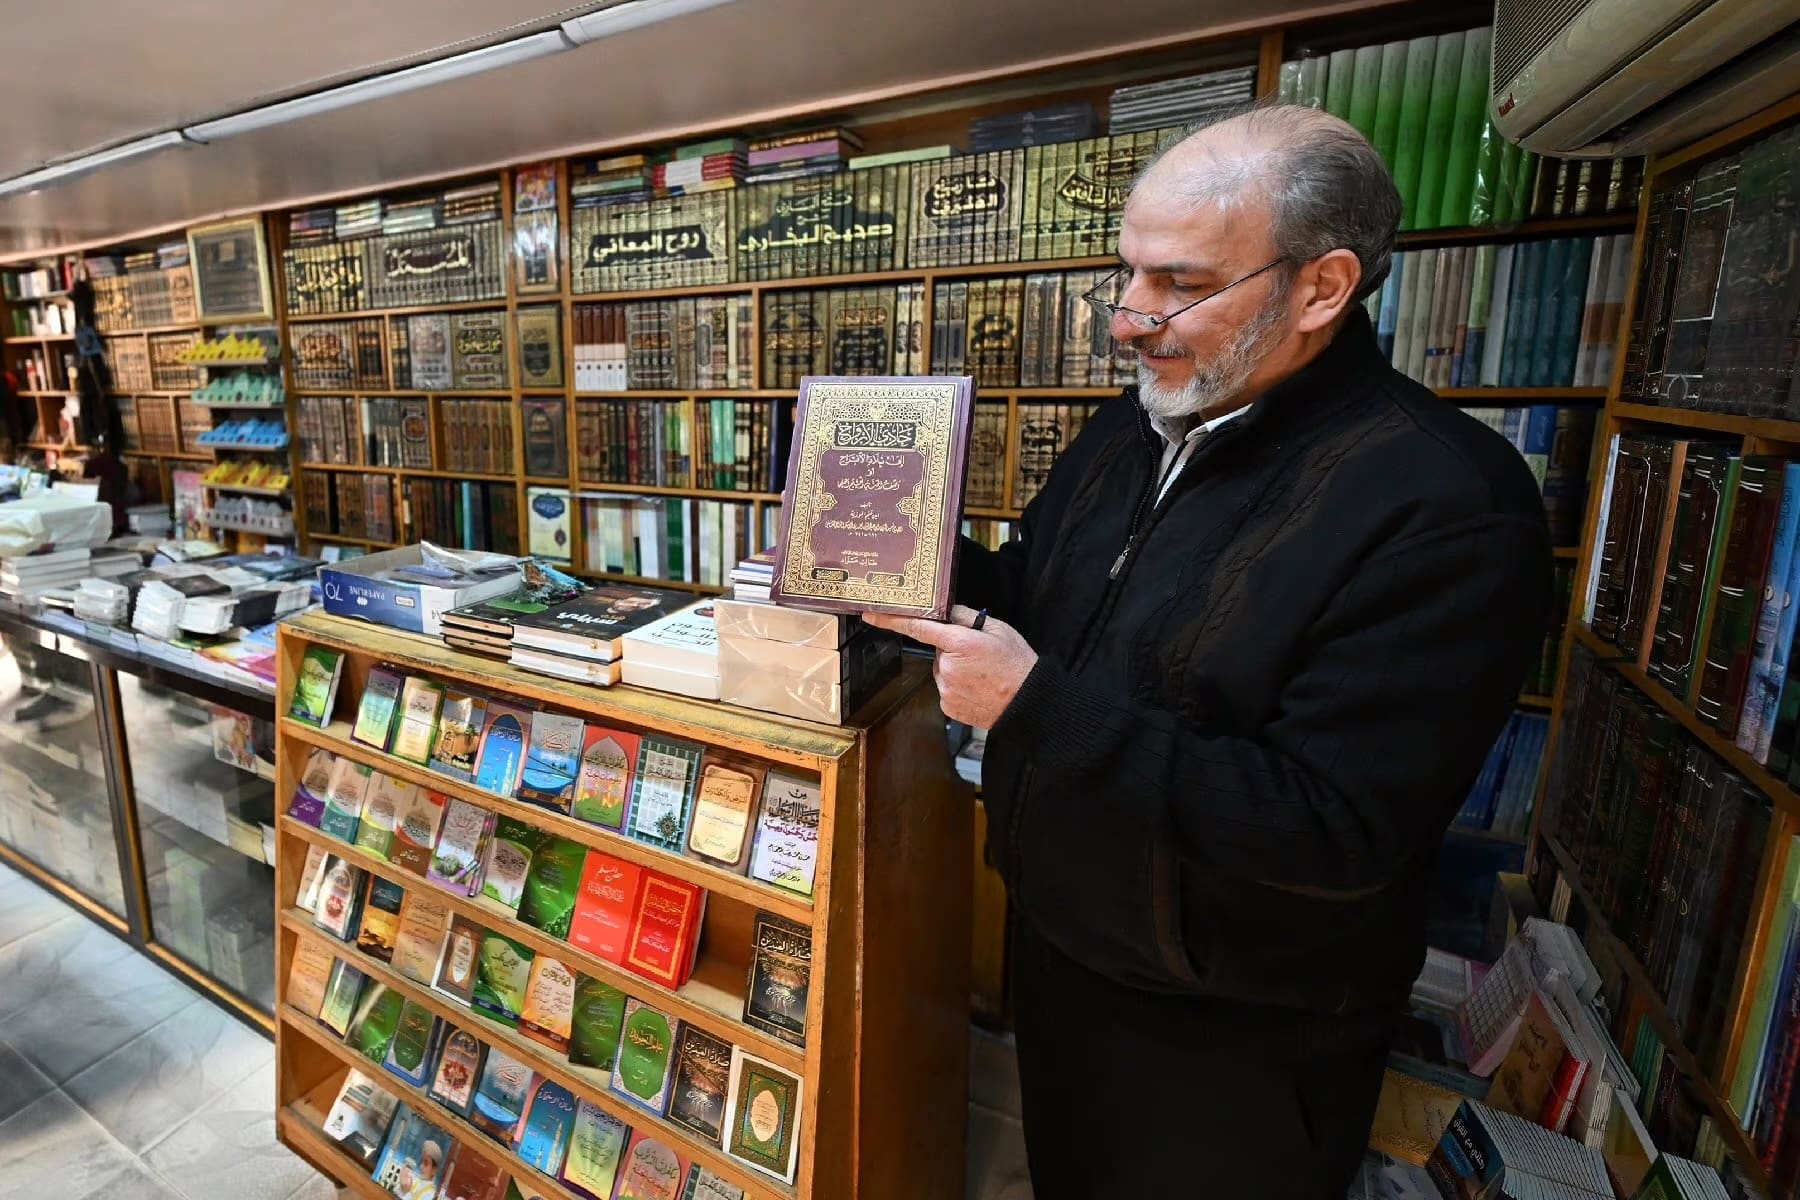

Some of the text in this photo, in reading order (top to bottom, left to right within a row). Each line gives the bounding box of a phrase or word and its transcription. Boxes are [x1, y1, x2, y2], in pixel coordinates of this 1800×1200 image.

[934, 175, 996, 198] تاريخ
[931, 193, 998, 214] الطبري
[593, 231, 663, 262] المعاني
[666, 231, 699, 253] روح
[738, 223, 893, 251] صحيح البخاري
[325, 582, 385, 601] 70 PAPERLINE
[788, 788, 807, 799] من
[760, 936, 811, 959] صلاة العيدين
[685, 1041, 730, 1067] صلاة العيدين
